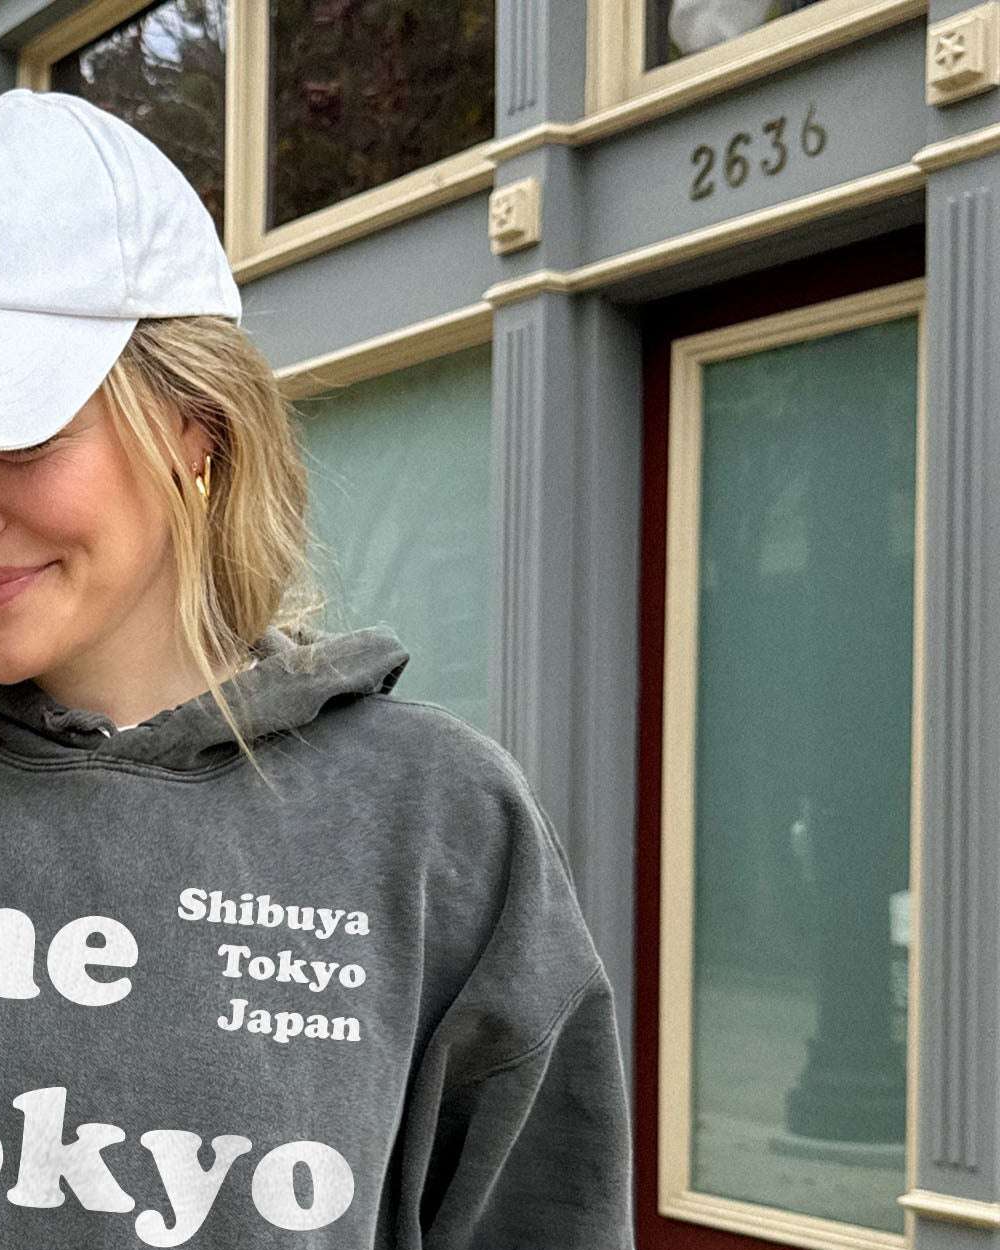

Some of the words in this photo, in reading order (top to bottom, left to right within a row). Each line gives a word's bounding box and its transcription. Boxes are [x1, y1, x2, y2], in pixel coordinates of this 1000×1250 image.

[689, 102, 828, 202] 2636
[177, 887, 370, 940] Shibuya
[217, 943, 367, 993] Tokyo
[216, 998, 362, 1044] Japan
